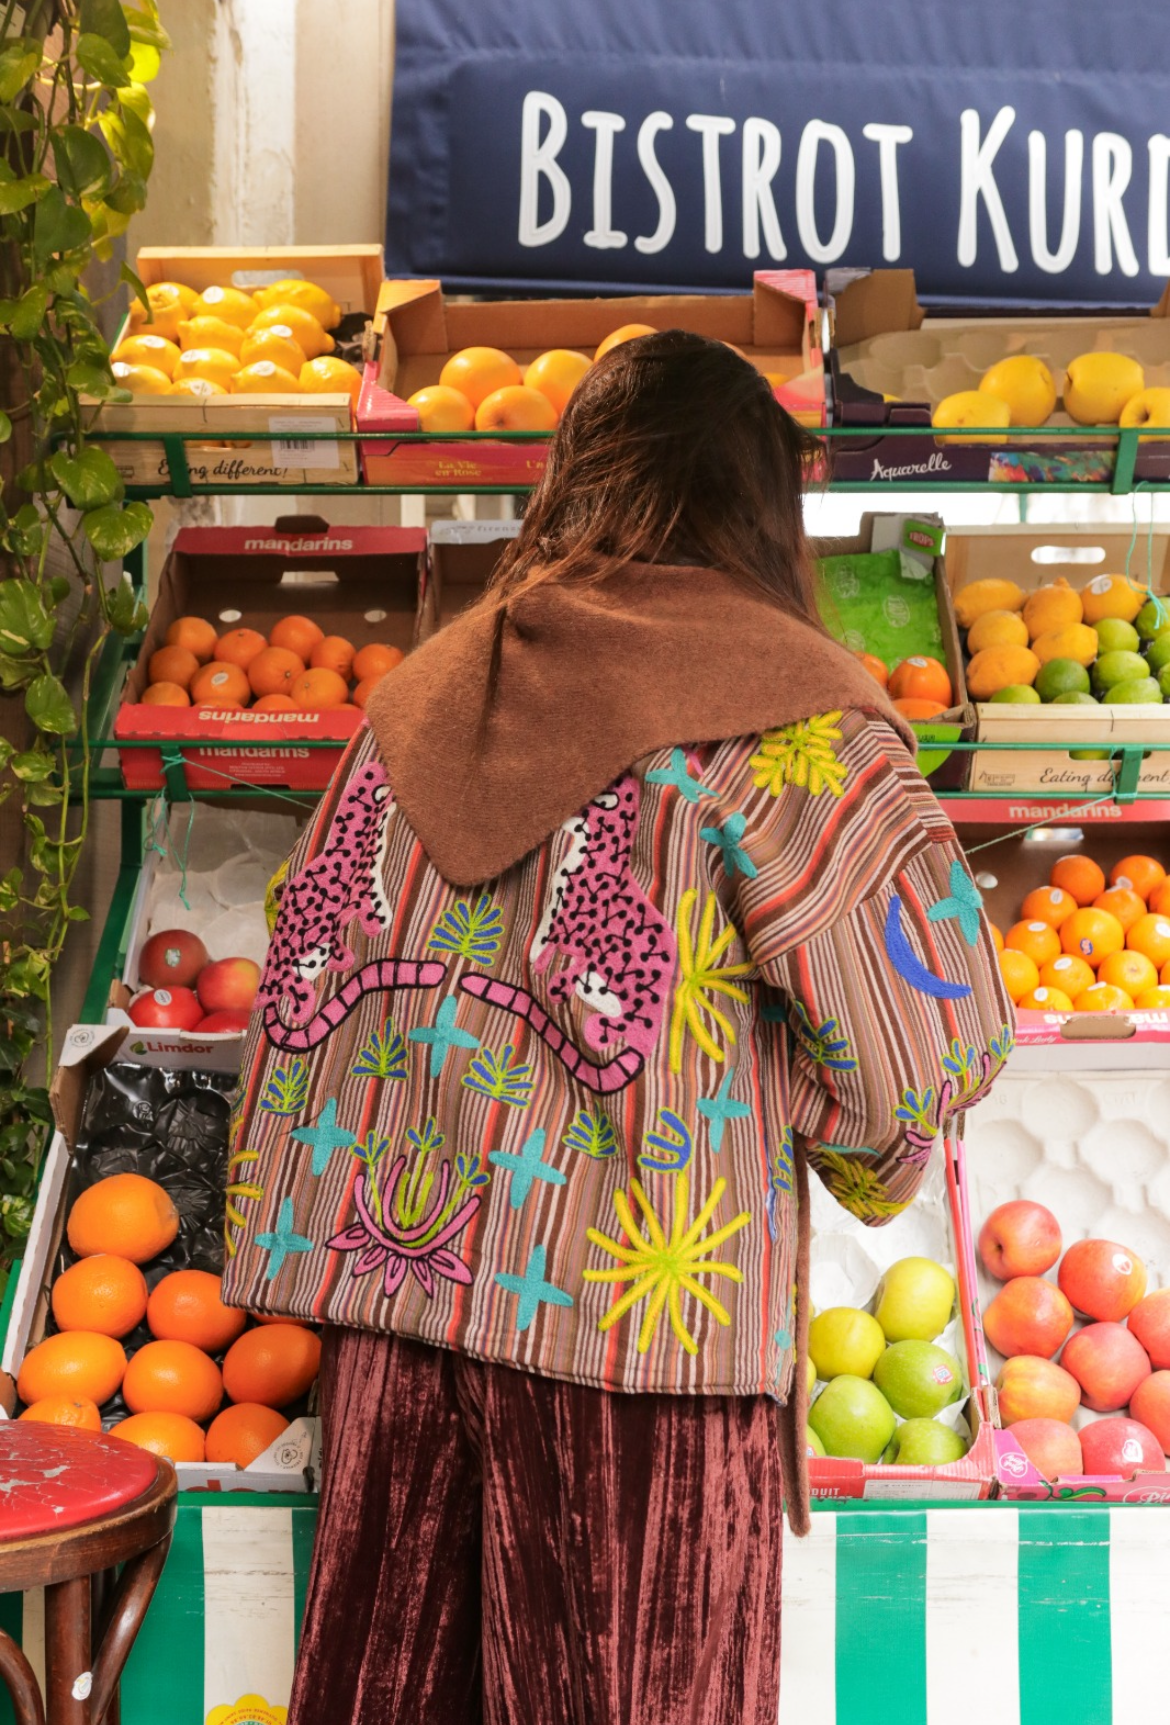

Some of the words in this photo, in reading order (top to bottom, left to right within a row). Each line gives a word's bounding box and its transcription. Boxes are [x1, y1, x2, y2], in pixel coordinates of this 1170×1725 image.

[517, 91, 913, 263] BISTROT
[158, 459, 207, 479] Eng
[870, 452, 953, 481] Aquarelle
[244, 537, 353, 551] mandarins
[198, 711, 320, 723] mandarins
[1040, 768, 1092, 786] Eating
[1009, 802, 1122, 819] mandarins
[147, 1041, 214, 1054] Limdor
